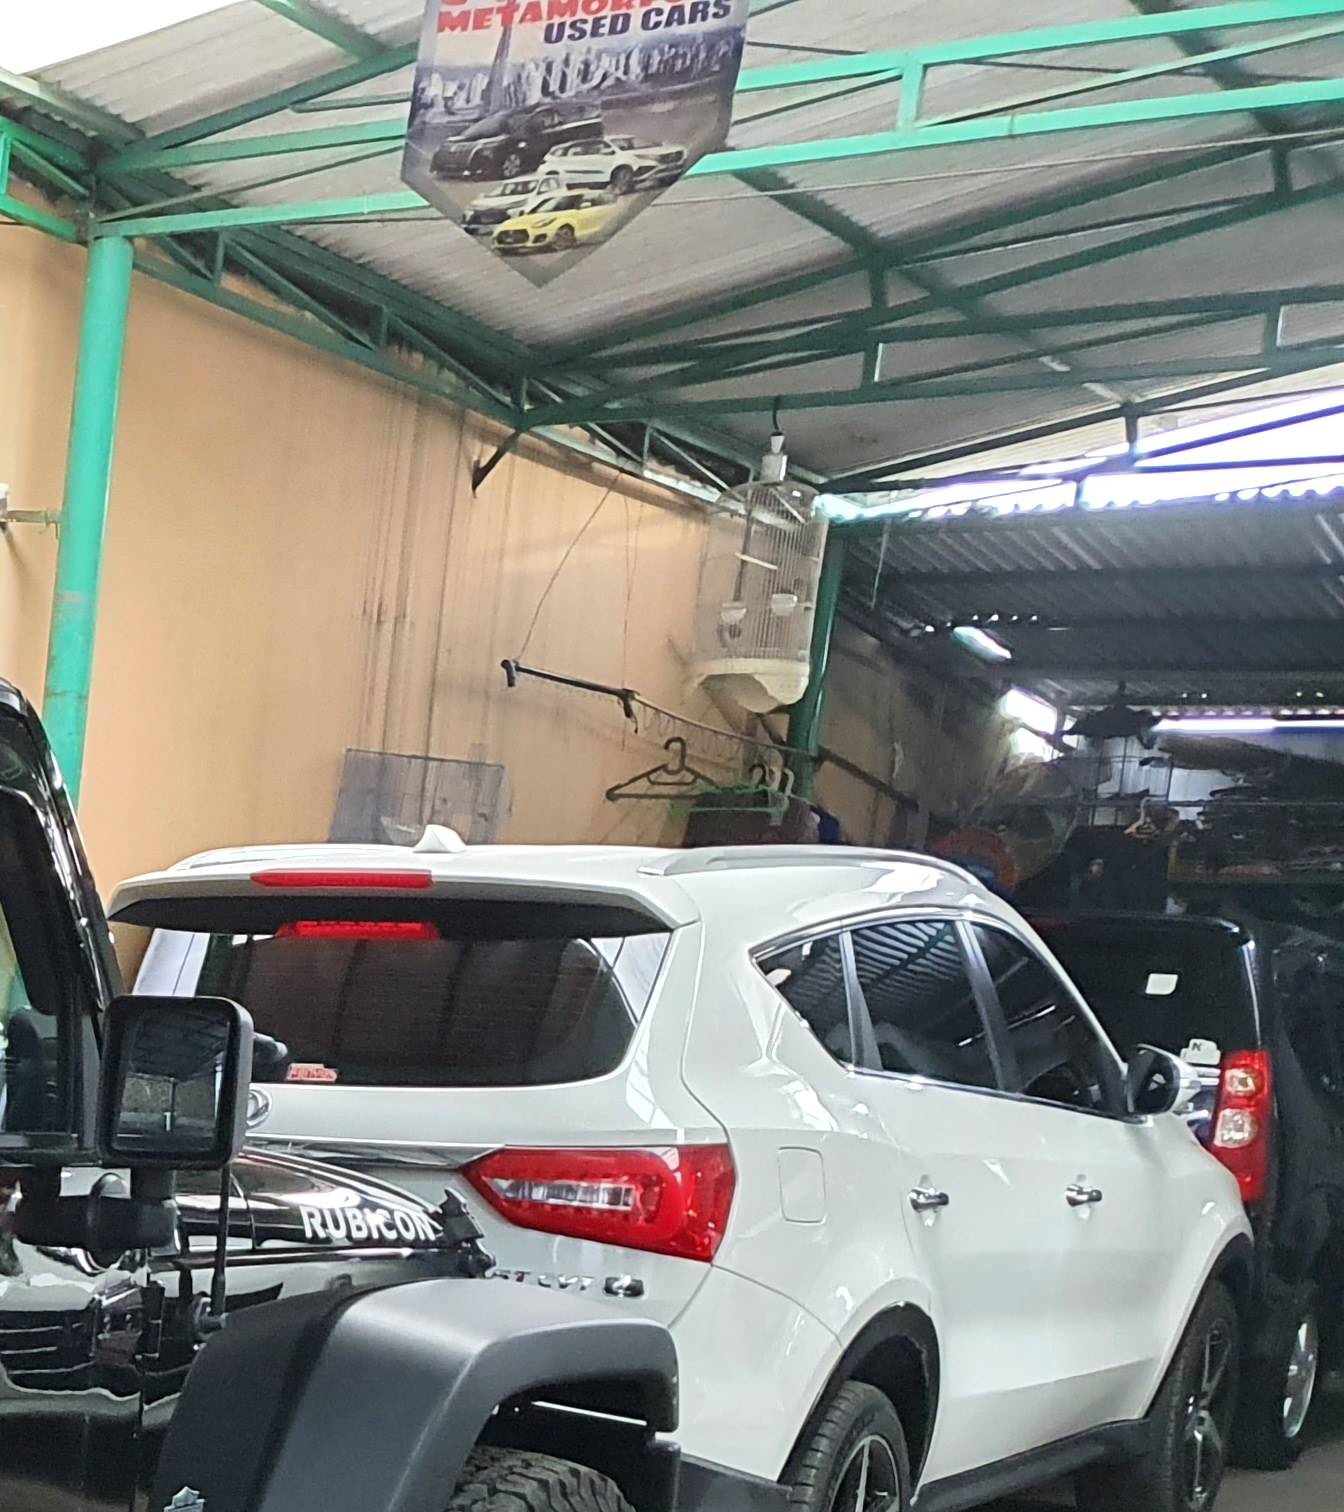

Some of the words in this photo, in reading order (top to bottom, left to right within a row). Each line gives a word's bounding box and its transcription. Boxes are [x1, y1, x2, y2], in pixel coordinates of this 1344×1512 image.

[543, 13, 631, 44] USED
[640, 0, 731, 31] CARS
[299, 1204, 443, 1241] RUBICON
